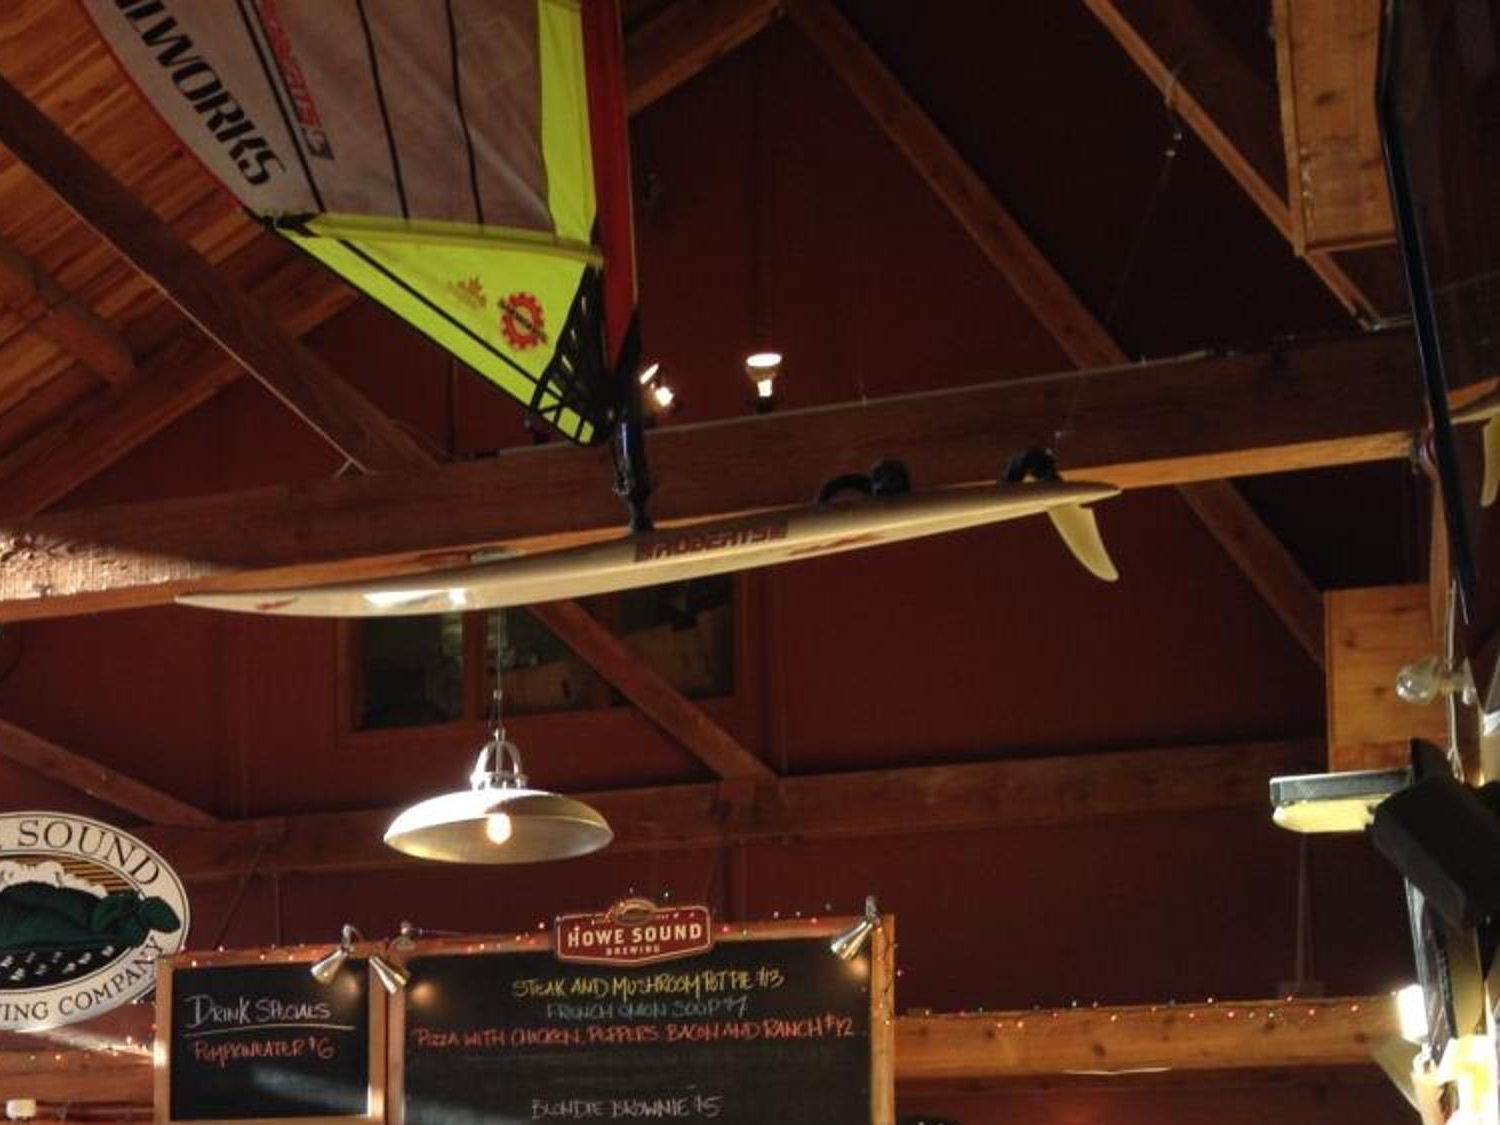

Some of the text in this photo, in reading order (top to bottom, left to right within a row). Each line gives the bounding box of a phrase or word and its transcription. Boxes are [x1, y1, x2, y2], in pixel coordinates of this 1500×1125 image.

[17, 819, 160, 885] SOUND
[567, 922, 702, 948] HOWE SOUND
[605, 944, 661, 956] BREWING
[59, 935, 166, 1014] COMPANY
[514, 977, 566, 998] STEAK
[571, 976, 609, 999] AND
[612, 973, 701, 1002] MUSHROOM
[702, 970, 729, 993] POT
[731, 968, 755, 991] PIE
[546, 1002, 614, 1021] FRENCH
[671, 998, 721, 1018] SOUP
[417, 1027, 460, 1047] PIZZA
[466, 1026, 504, 1046] WITH
[667, 1021, 720, 1043] BACON
[723, 1020, 761, 1041] AND
[763, 1015, 823, 1039] RANCH
[531, 1099, 605, 1121] BLONDIE
[612, 1096, 691, 1119] BROWNIE
